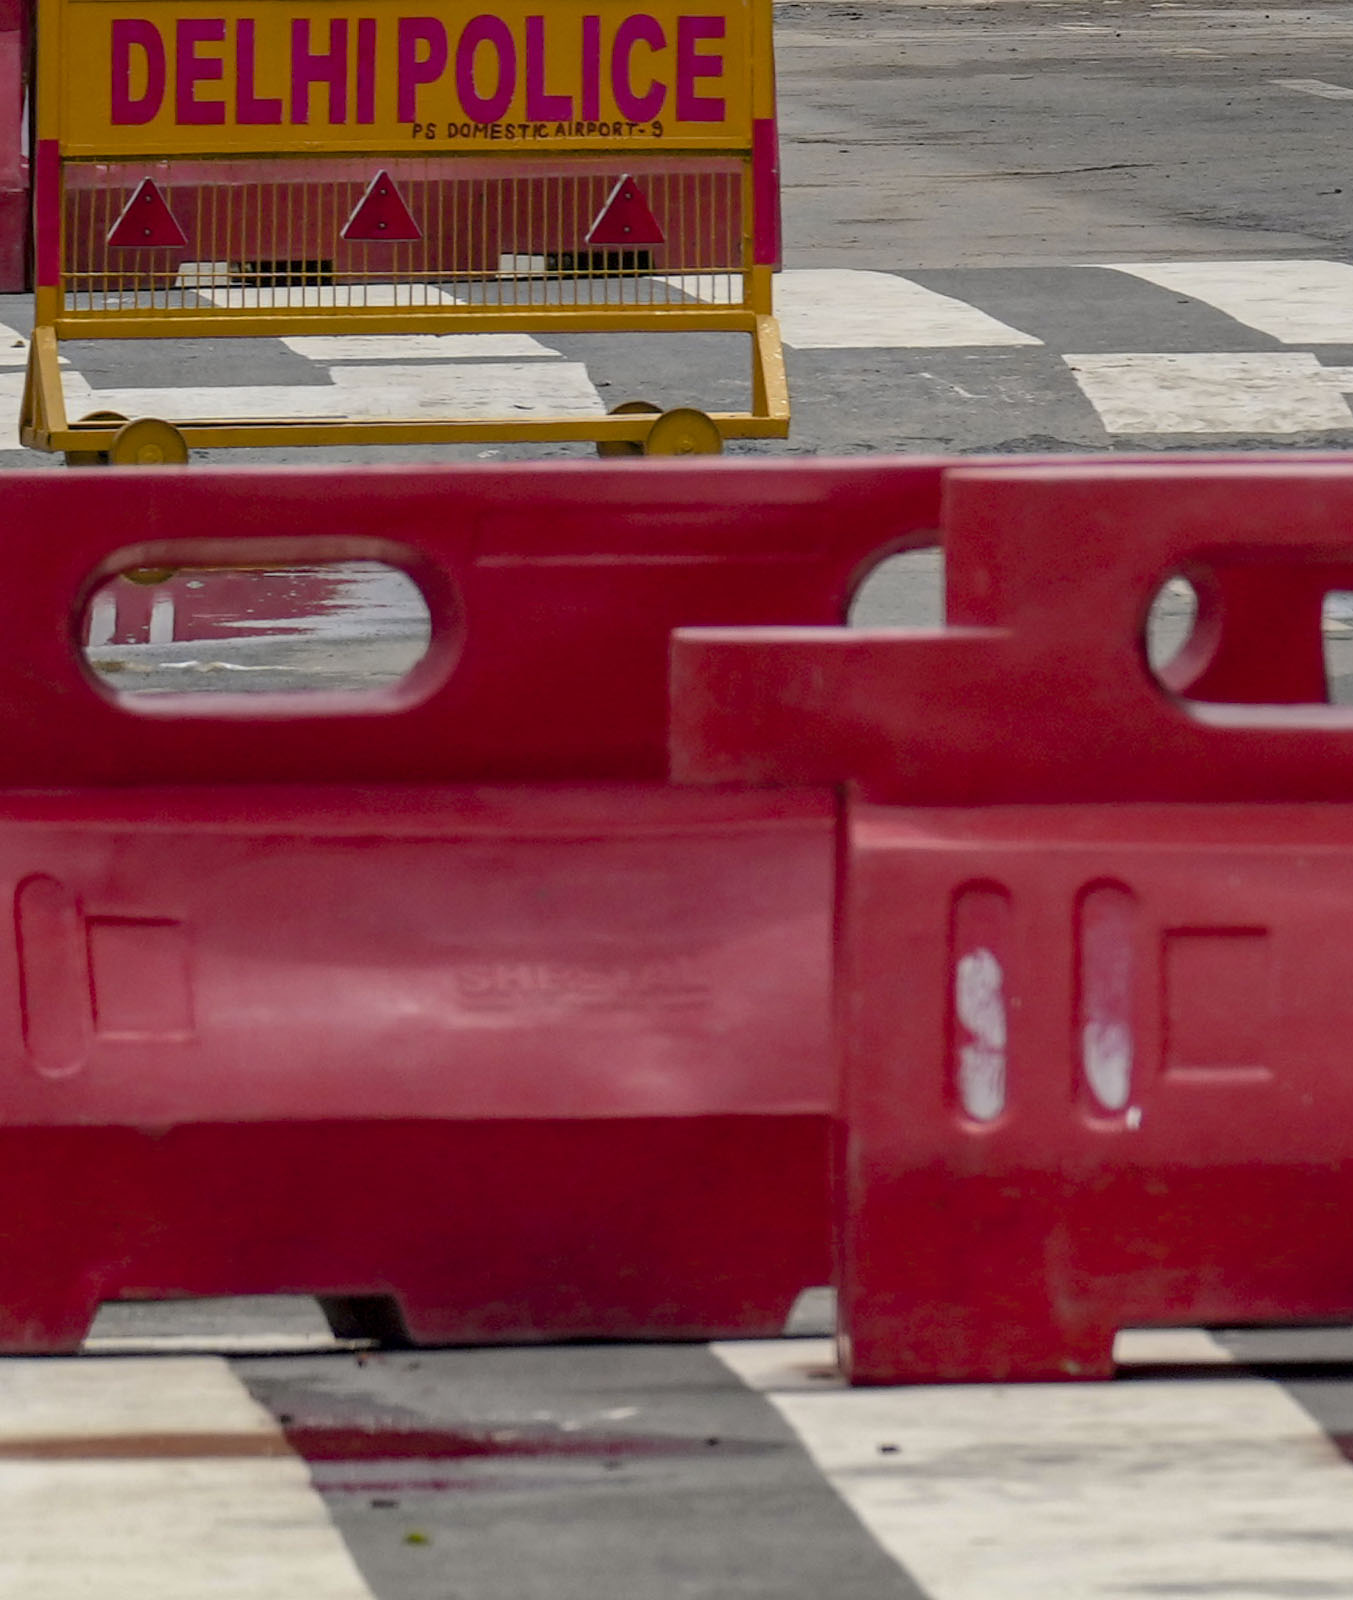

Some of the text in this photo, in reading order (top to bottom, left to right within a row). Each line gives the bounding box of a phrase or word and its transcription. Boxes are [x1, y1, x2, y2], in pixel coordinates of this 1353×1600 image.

[111, 14, 726, 125] DELHI POLICE
[412, 122, 436, 140] PS
[448, 121, 548, 140] DOMESTIC
